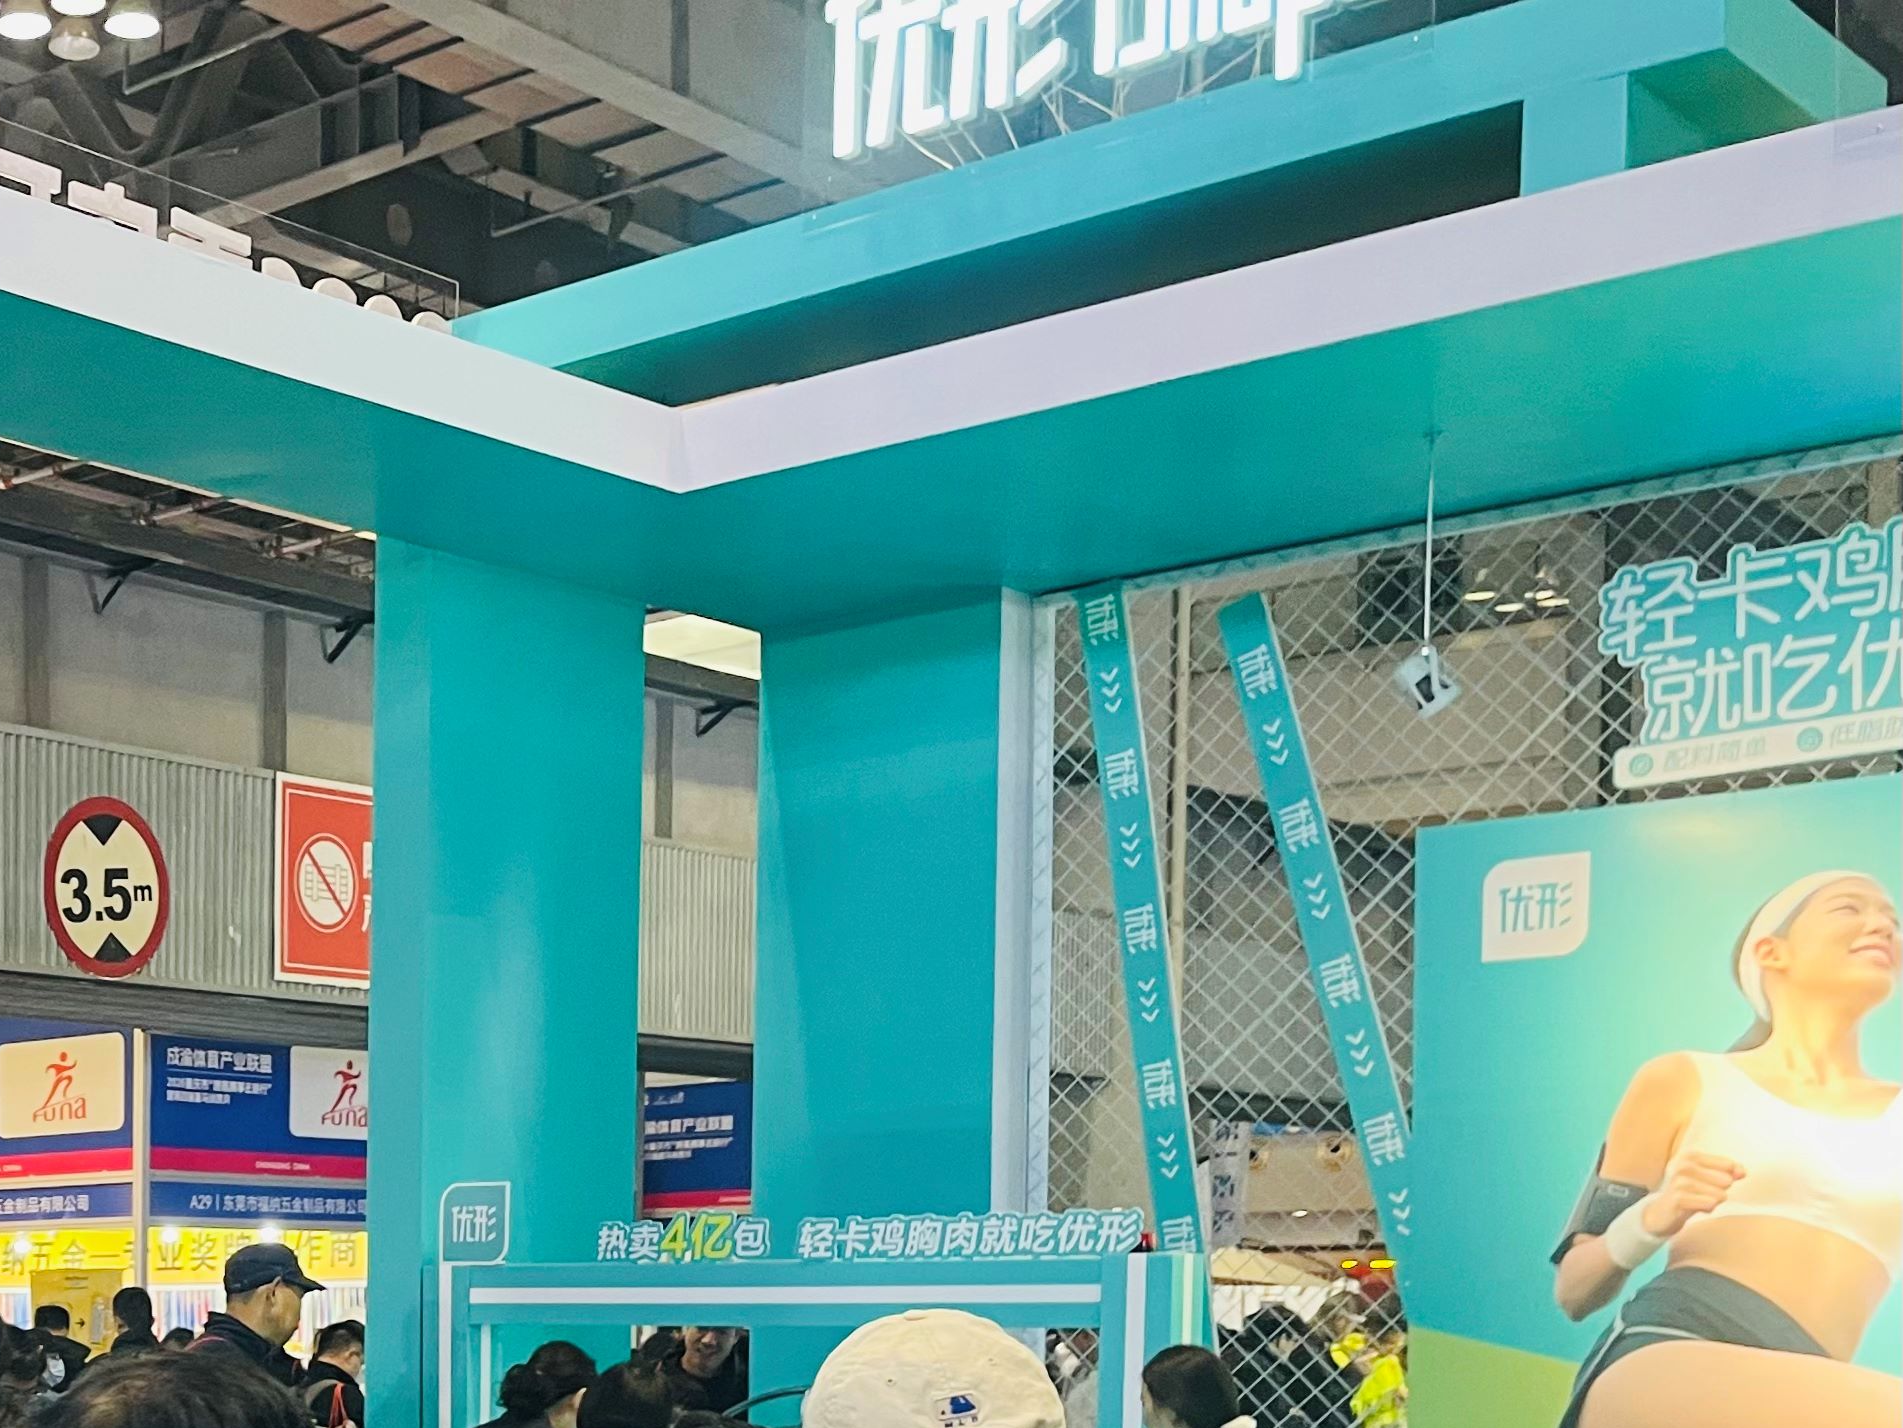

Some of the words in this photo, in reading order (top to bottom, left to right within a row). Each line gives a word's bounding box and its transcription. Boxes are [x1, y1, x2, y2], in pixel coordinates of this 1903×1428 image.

[1607, 524, 1903, 658] 轻卡鸡
[1498, 882, 1572, 933] 优形
[450, 1205, 497, 1243] 优形
[597, 1212, 767, 1261] 热卖4亿包
[798, 1211, 1142, 1258] 轻卡鸡胸肉就吃优形
